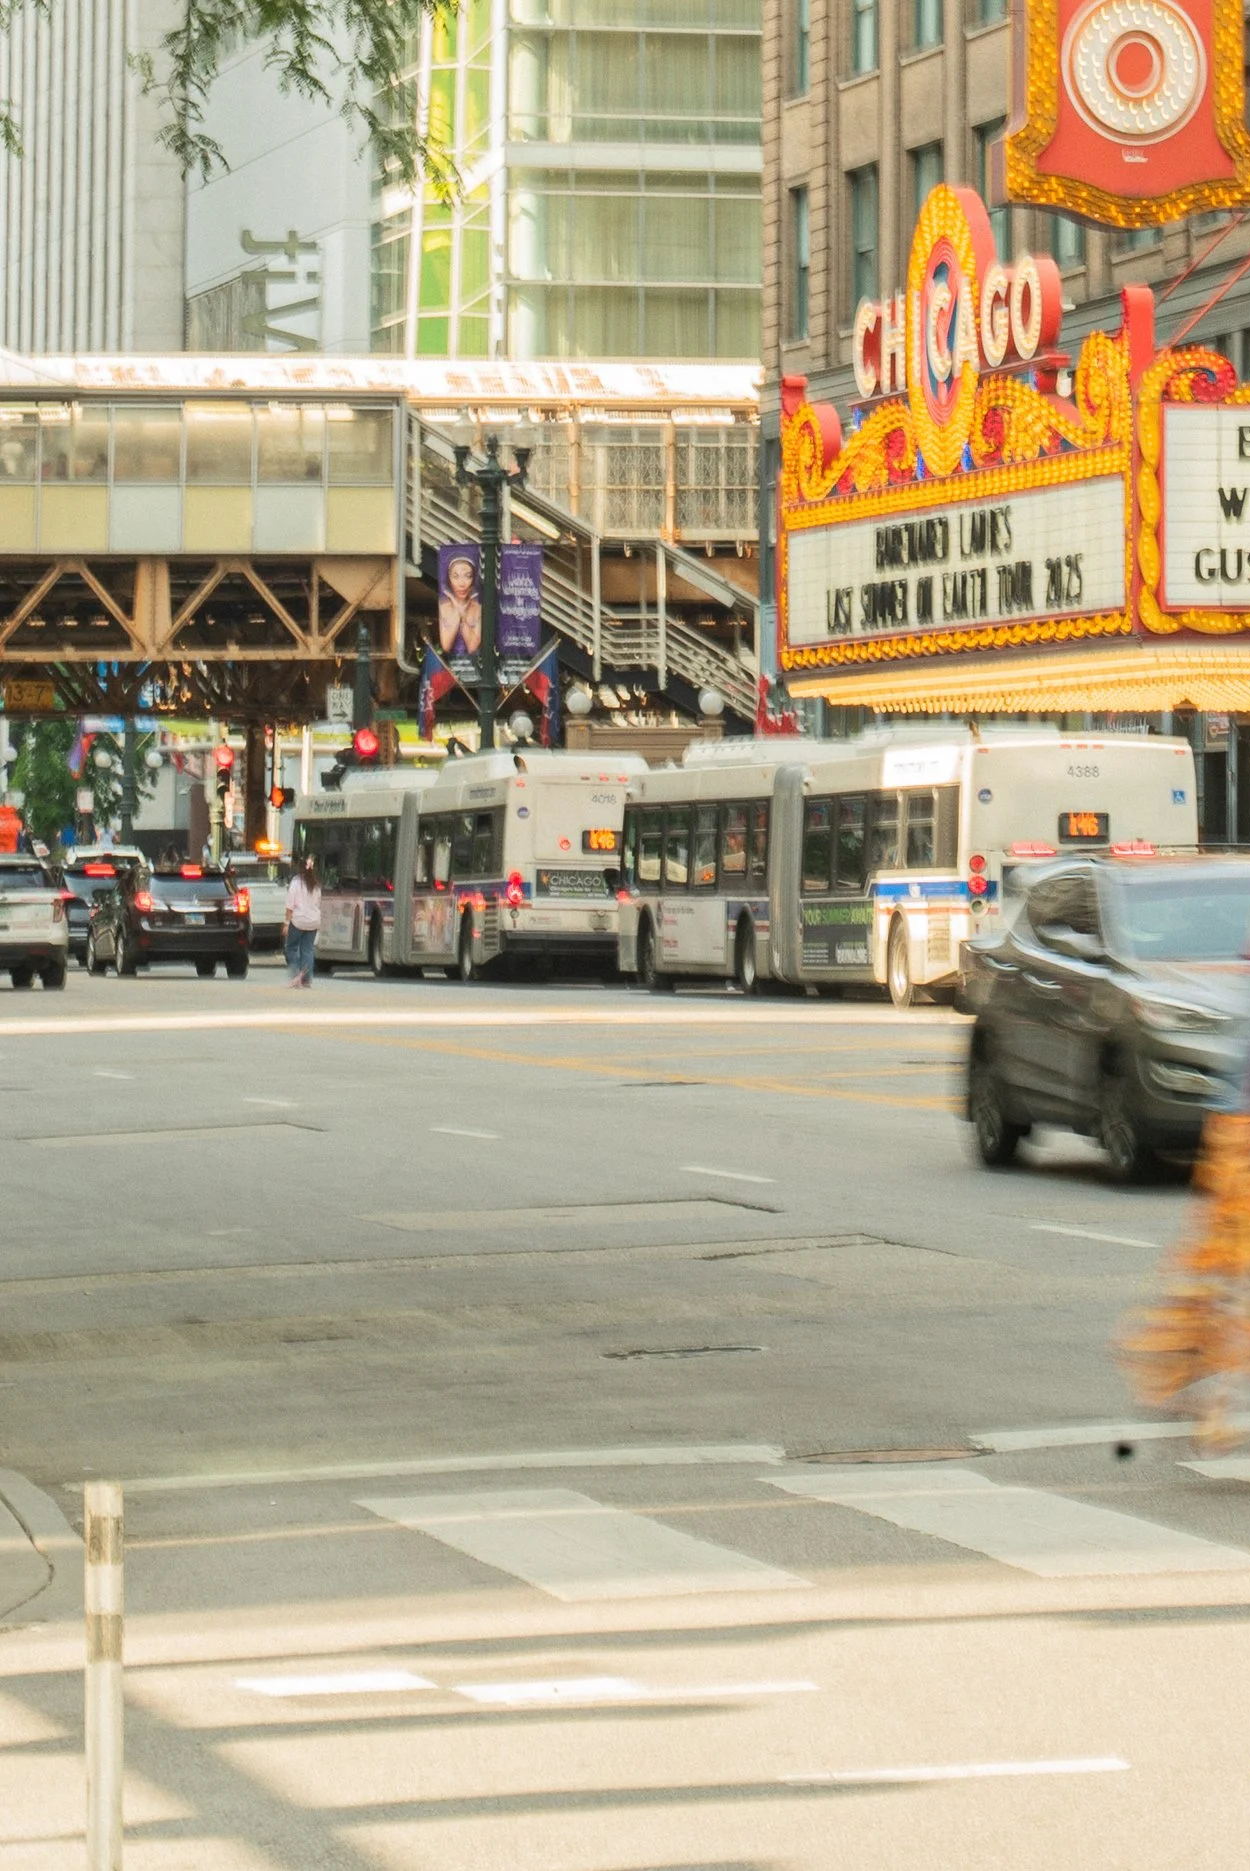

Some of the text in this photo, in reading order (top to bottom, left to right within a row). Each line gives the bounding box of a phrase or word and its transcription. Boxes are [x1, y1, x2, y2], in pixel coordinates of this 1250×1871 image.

[853, 255, 1042, 398] CHICAGO
[1045, 553, 1084, 610] 2025
[1067, 766, 1100, 778] 4388
[1069, 813, 1100, 837] 146
[550, 875, 602, 887] CHICAGO
